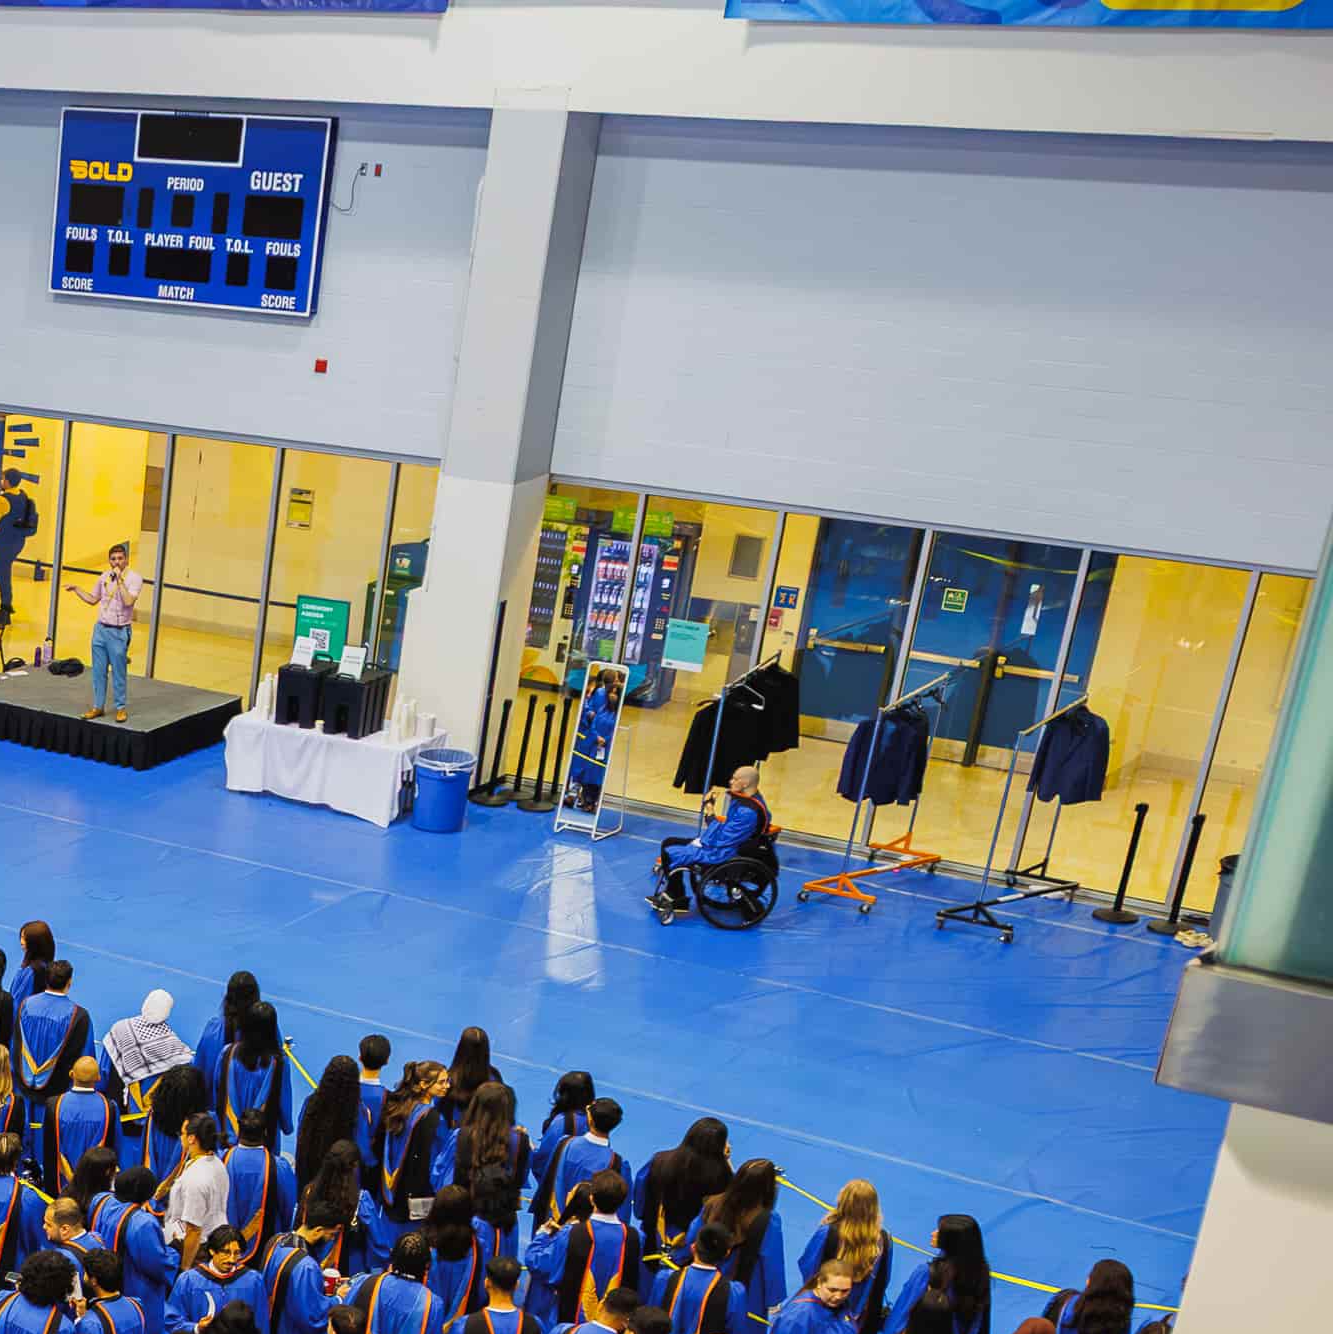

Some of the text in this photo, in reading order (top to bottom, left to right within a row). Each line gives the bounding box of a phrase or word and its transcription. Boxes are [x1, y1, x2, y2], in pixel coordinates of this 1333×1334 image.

[166, 176, 205, 192] PERIOD
[249, 171, 304, 193] GUEST
[65, 227, 301, 257] FOULS T.O.L. PLAYER FOUL T.O.L. FOULS
[61, 276, 296, 310] SCORE MATCH SCORE
